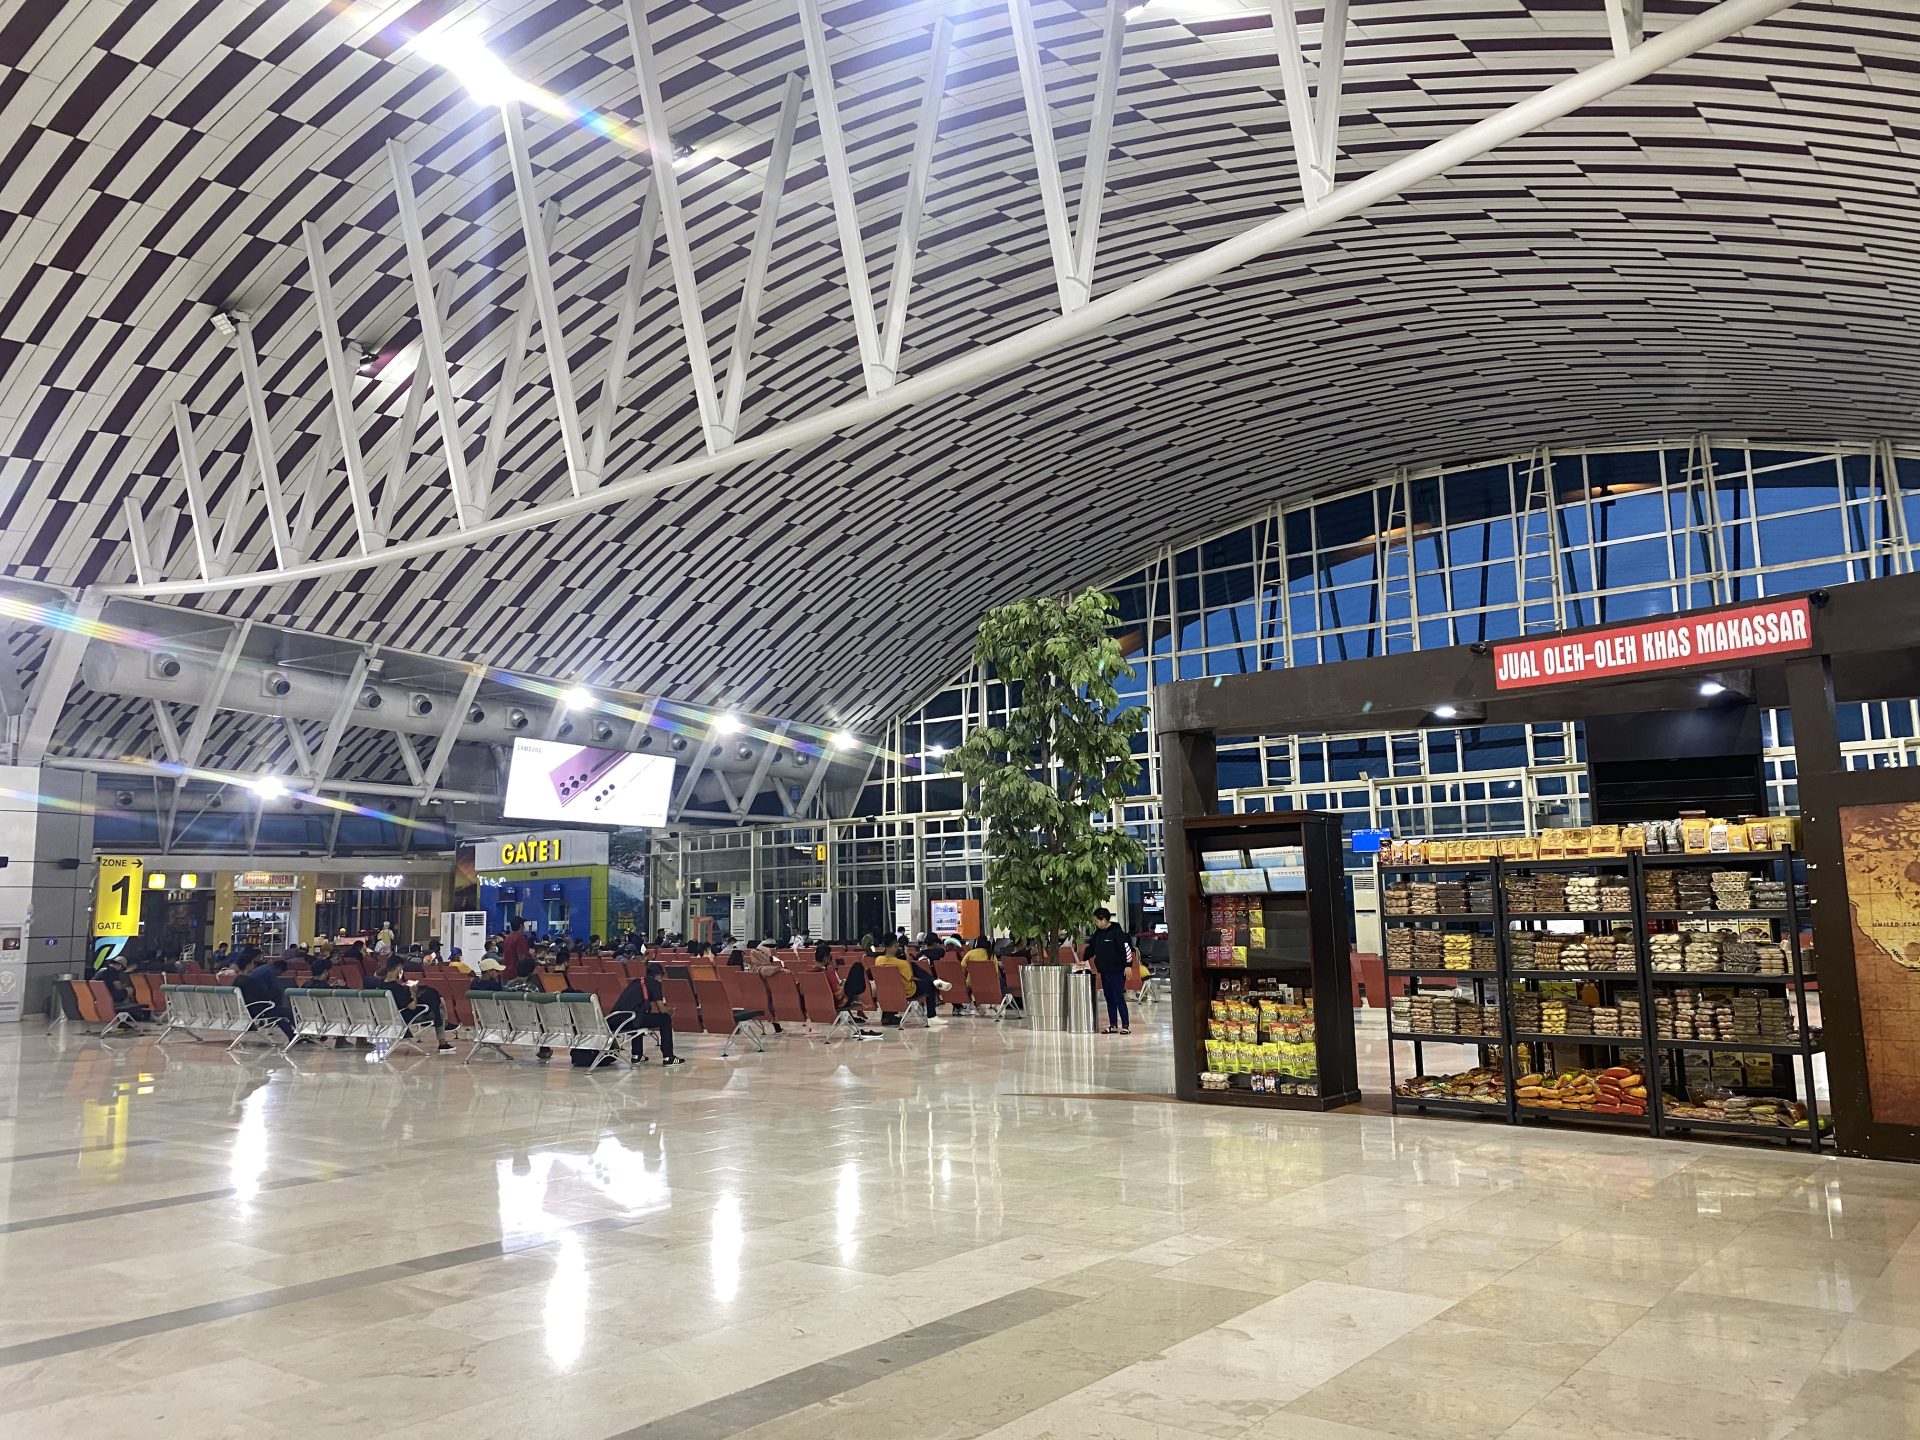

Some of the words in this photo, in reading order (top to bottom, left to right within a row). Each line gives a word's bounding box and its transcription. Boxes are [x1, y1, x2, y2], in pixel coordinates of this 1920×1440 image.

[1498, 650, 1541, 682] JUAL
[1543, 635, 1638, 676] OLEH-OLEH
[1641, 626, 1691, 662] KHAS
[1695, 609, 1808, 654] MAKASSAR
[102, 859, 127, 867] ZONE
[501, 840, 550, 865] GATE
[553, 839, 561, 861] 1
[111, 875, 131, 916] 1
[97, 922, 122, 930] GATE
